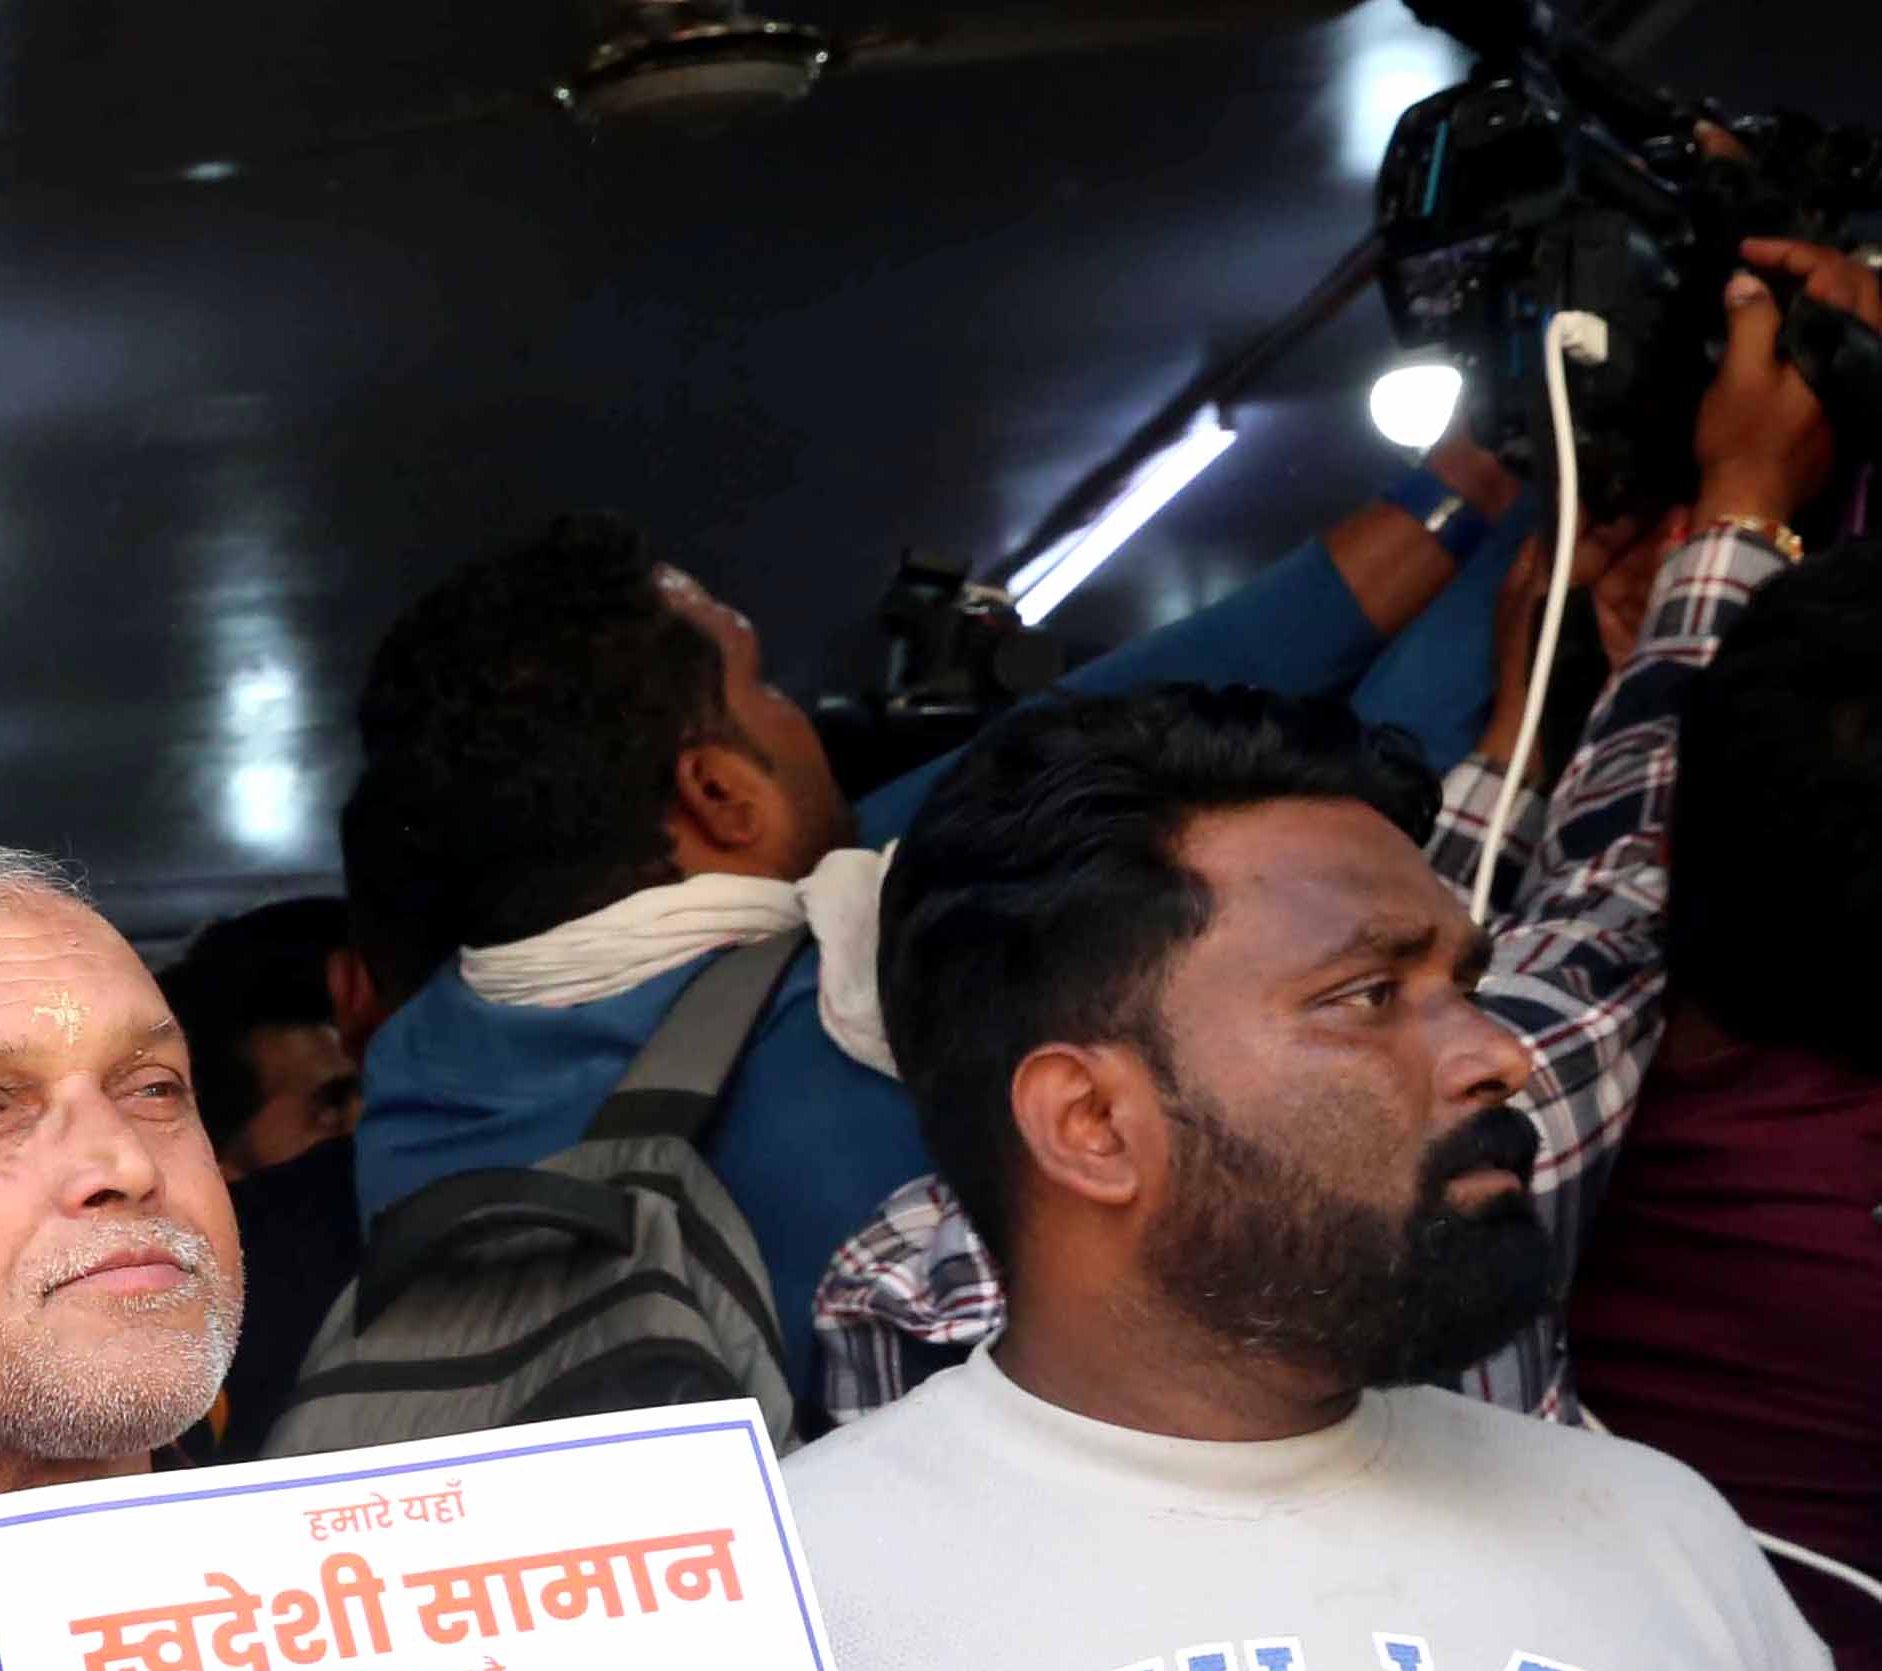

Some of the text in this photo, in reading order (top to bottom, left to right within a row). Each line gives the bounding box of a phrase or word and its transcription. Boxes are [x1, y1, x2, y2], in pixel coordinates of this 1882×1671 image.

[303, 1479, 465, 1542] हमारे यहाँ
[401, 1527, 744, 1645] सामान
